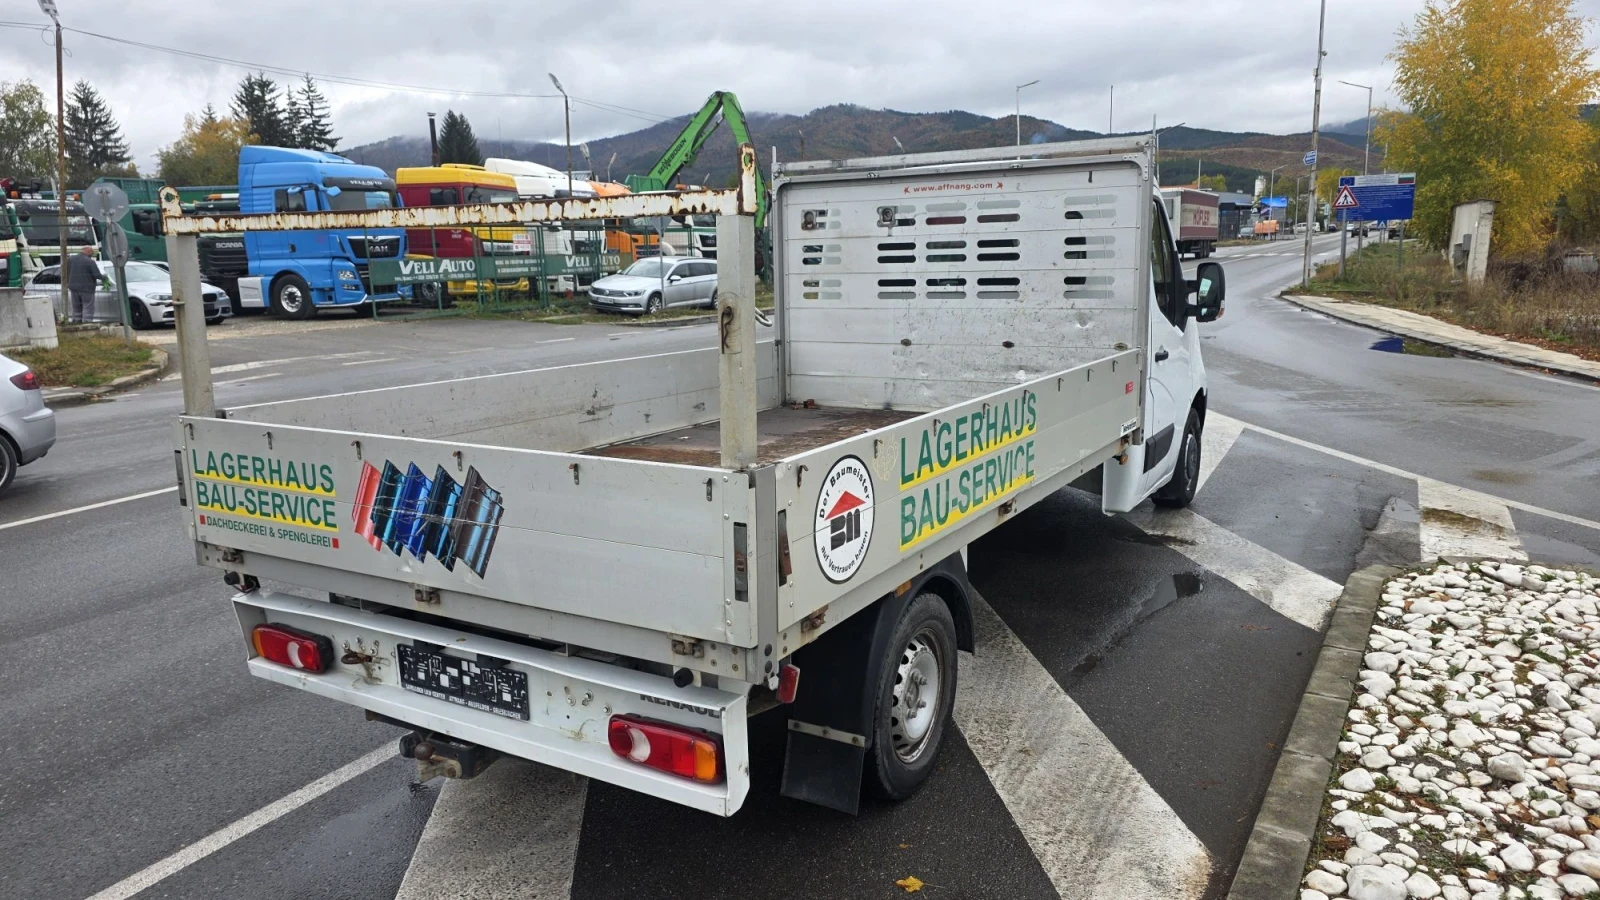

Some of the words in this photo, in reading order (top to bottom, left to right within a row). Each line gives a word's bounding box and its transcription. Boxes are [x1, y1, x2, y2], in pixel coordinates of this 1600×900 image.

[913, 182, 993, 193] www.affnang.com
[900, 392, 1037, 486] LAGERHAUS
[192, 448, 335, 493] LAGERHAUS
[819, 489, 831, 519] Der
[829, 465, 870, 500] Baumeister
[900, 440, 1035, 546] BAU-SERVICE
[195, 480, 338, 529] BAU-SERVICE
[206, 515, 267, 536] DACHDECKEREI
[269, 527, 276, 538] &
[277, 528, 331, 548] SPENGLEREI
[821, 545, 830, 559] auf
[828, 558, 855, 574] Vertrauen
[854, 531, 869, 561] bauen
